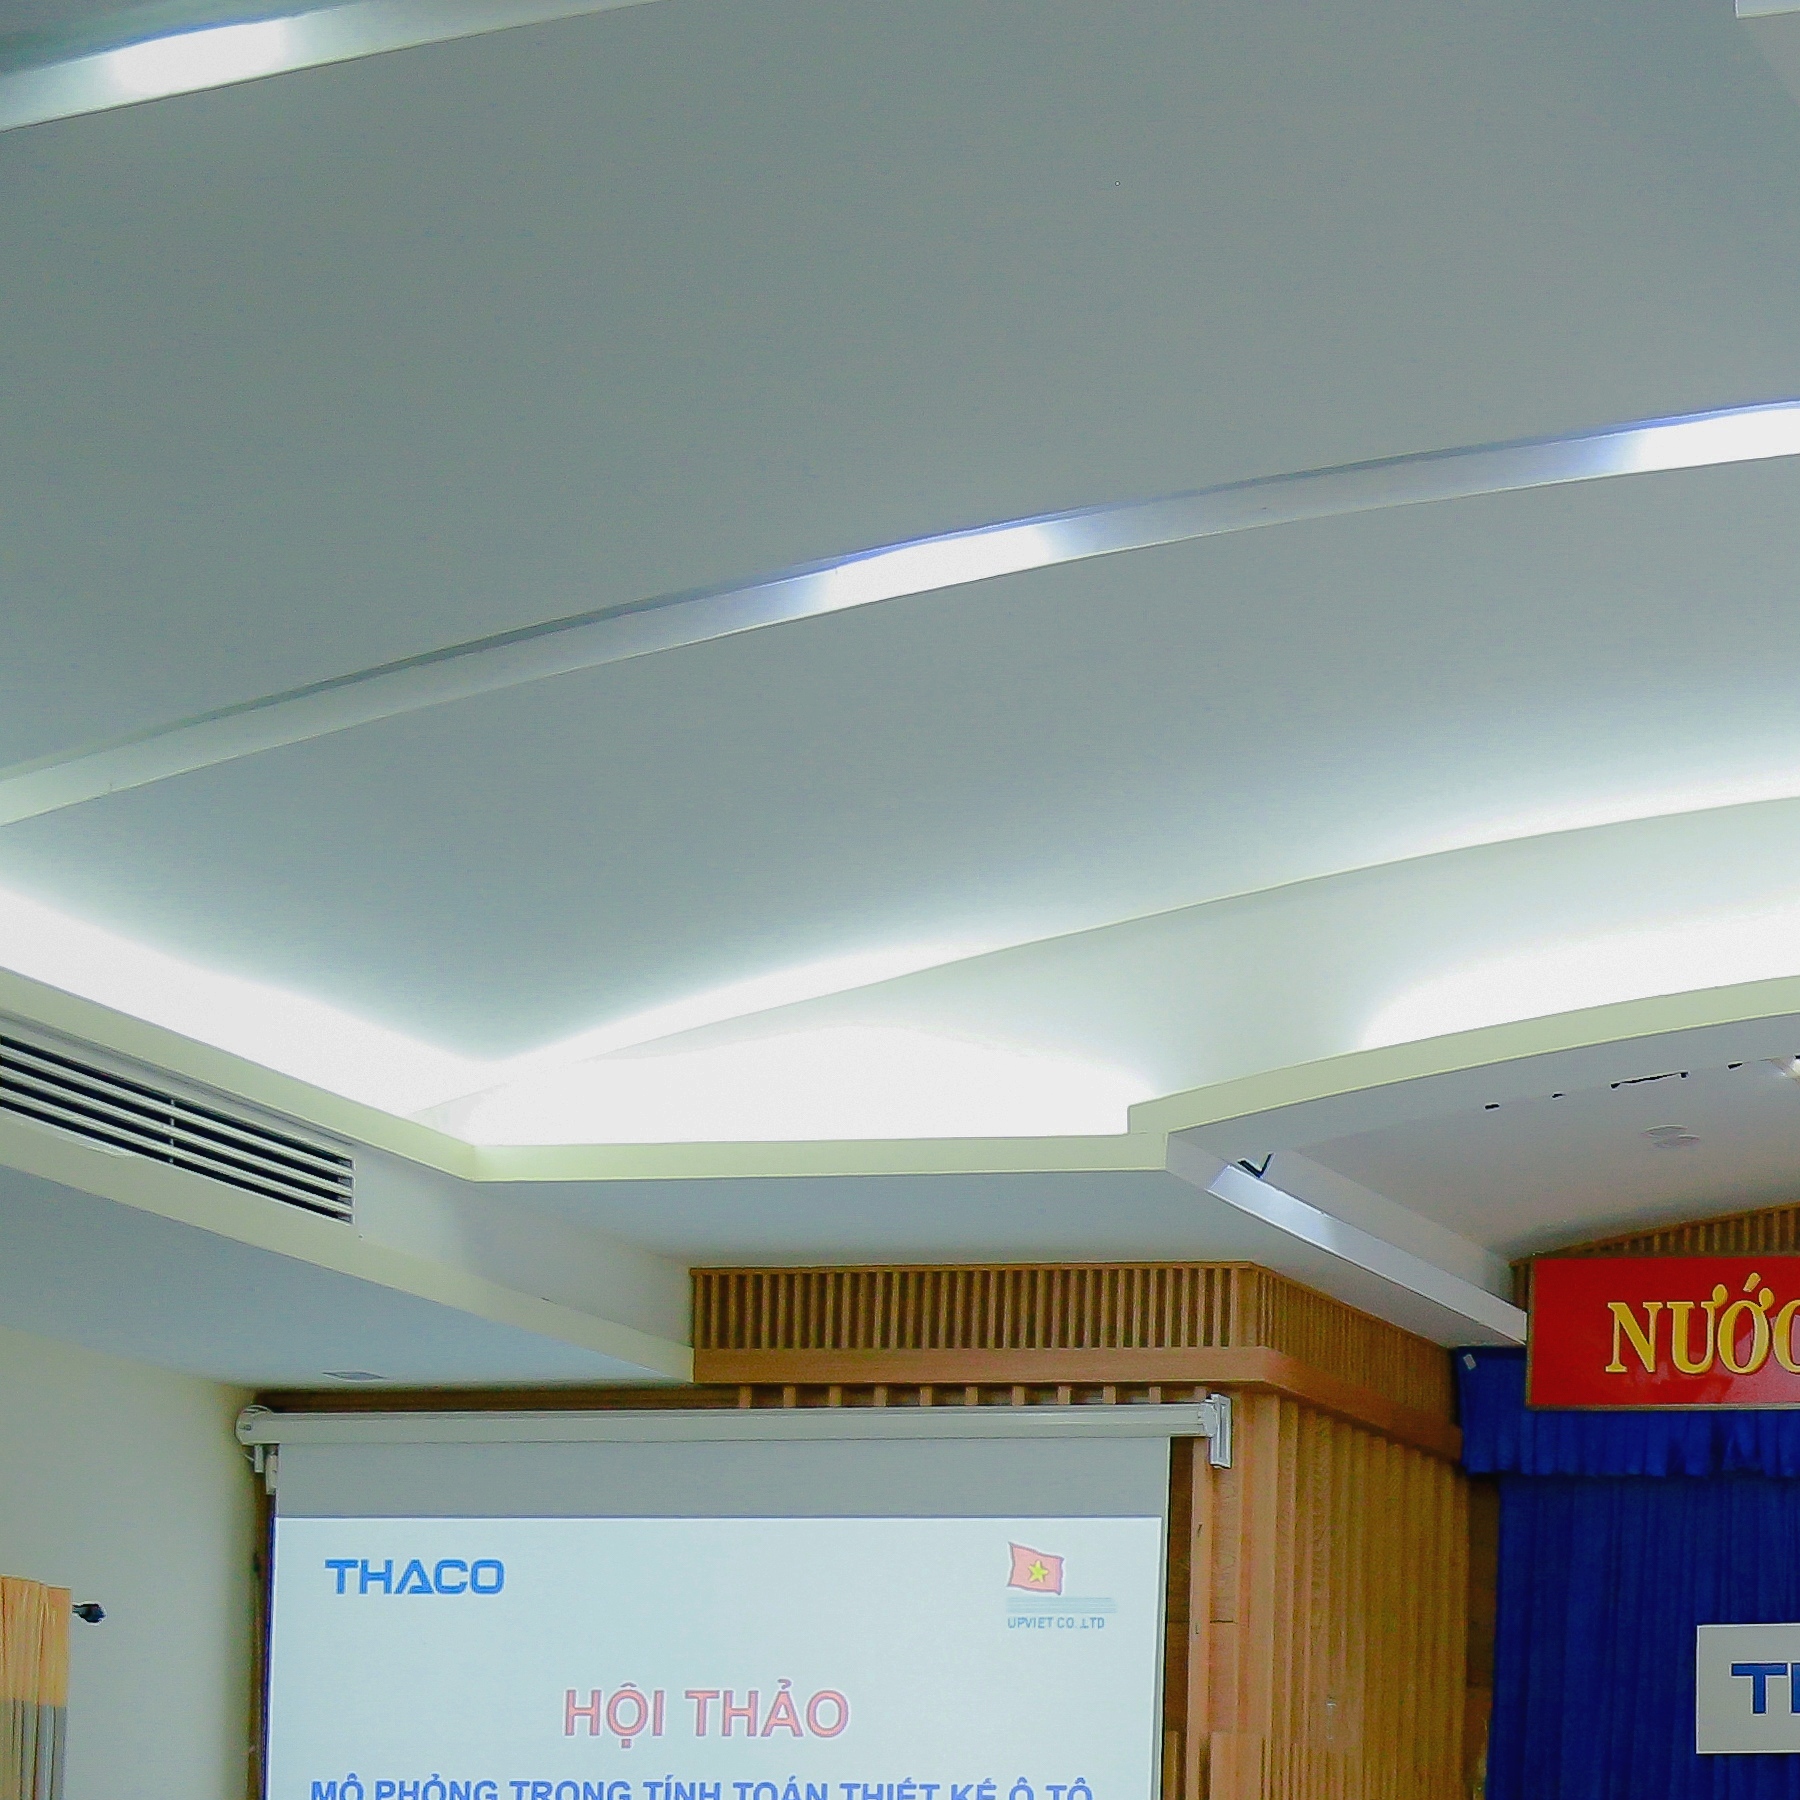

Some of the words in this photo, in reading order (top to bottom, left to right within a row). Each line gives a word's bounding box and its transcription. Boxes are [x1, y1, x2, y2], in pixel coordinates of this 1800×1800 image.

[325, 1558, 505, 1596] THACO
[564, 1681, 664, 1748] HỘI
[686, 1678, 849, 1739] THẢO
